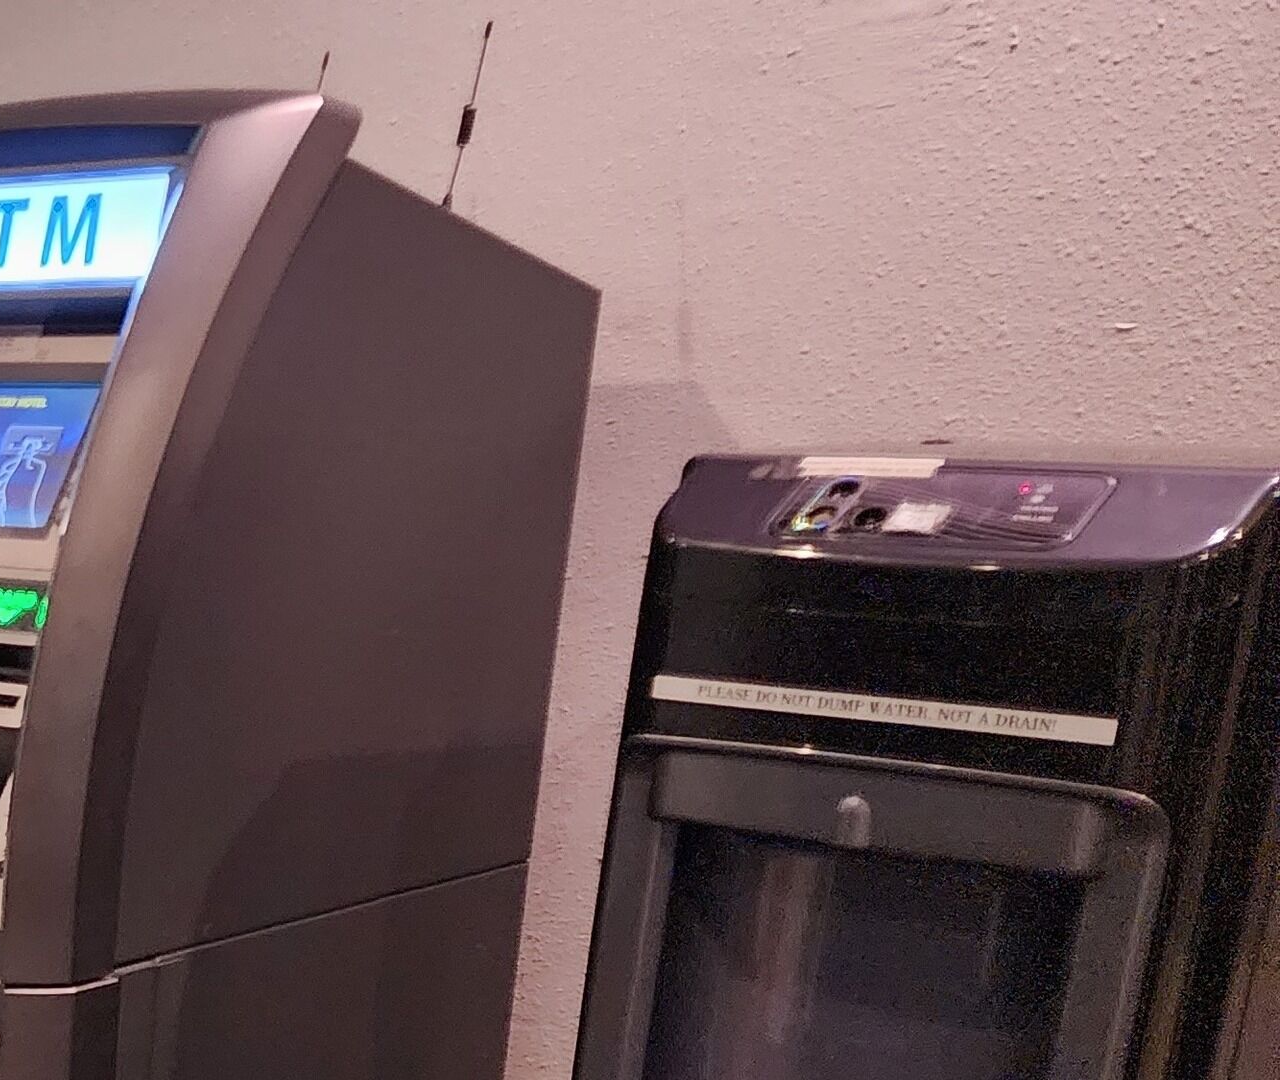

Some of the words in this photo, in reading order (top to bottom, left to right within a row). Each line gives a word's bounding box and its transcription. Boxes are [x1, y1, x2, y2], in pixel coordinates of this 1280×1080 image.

[697, 685, 752, 701] PLEASE
[756, 690, 778, 703] DO
[781, 693, 815, 707] NOT
[817, 696, 864, 712] DUMP
[938, 708, 972, 723] NOT
[979, 713, 990, 726] A
[994, 713, 1058, 732] DRAIN!
